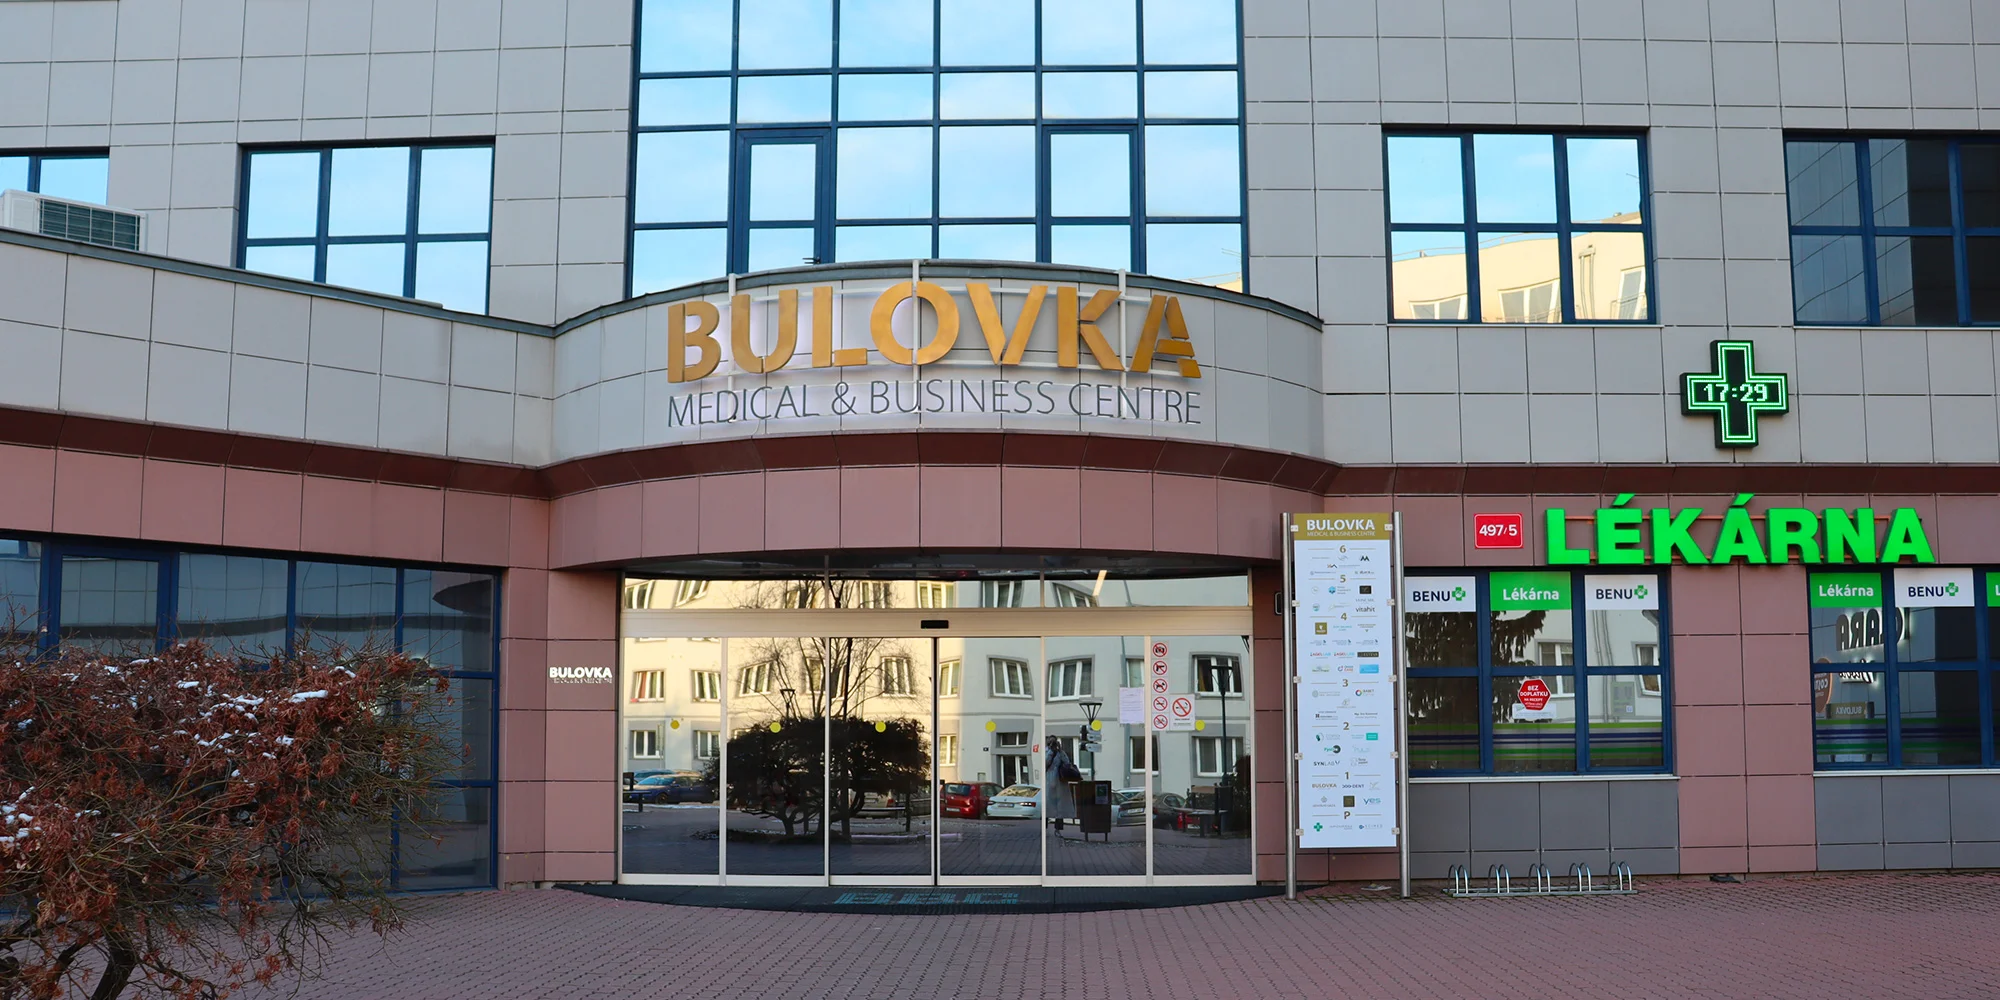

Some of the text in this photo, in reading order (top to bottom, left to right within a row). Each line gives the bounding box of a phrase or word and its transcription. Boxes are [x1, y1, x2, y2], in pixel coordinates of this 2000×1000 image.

[667, 280, 1202, 383] BULOVKA
[1703, 383, 1768, 402] 17:29
[668, 379, 1202, 427] MEDICAL & BUSINESS CENTRE
[1306, 519, 1375, 531] BULOVKA
[1478, 524, 1518, 537] 497/5
[1544, 493, 1936, 565] LÉKÁRNA
[1339, 544, 1346, 553] 6
[1340, 574, 1346, 583] 5
[1412, 590, 1450, 602] BENU
[1503, 587, 1559, 600] Lékárna
[1596, 588, 1633, 600] BENU
[1818, 584, 1874, 597] Lékárna
[1908, 586, 1944, 597] BENU
[1340, 612, 1347, 621] 4
[549, 667, 612, 678] BULOVKA
[1342, 678, 1349, 687] 3
[1343, 722, 1349, 730] 2
[1345, 771, 1349, 780] 1
[1344, 811, 1351, 820] P
